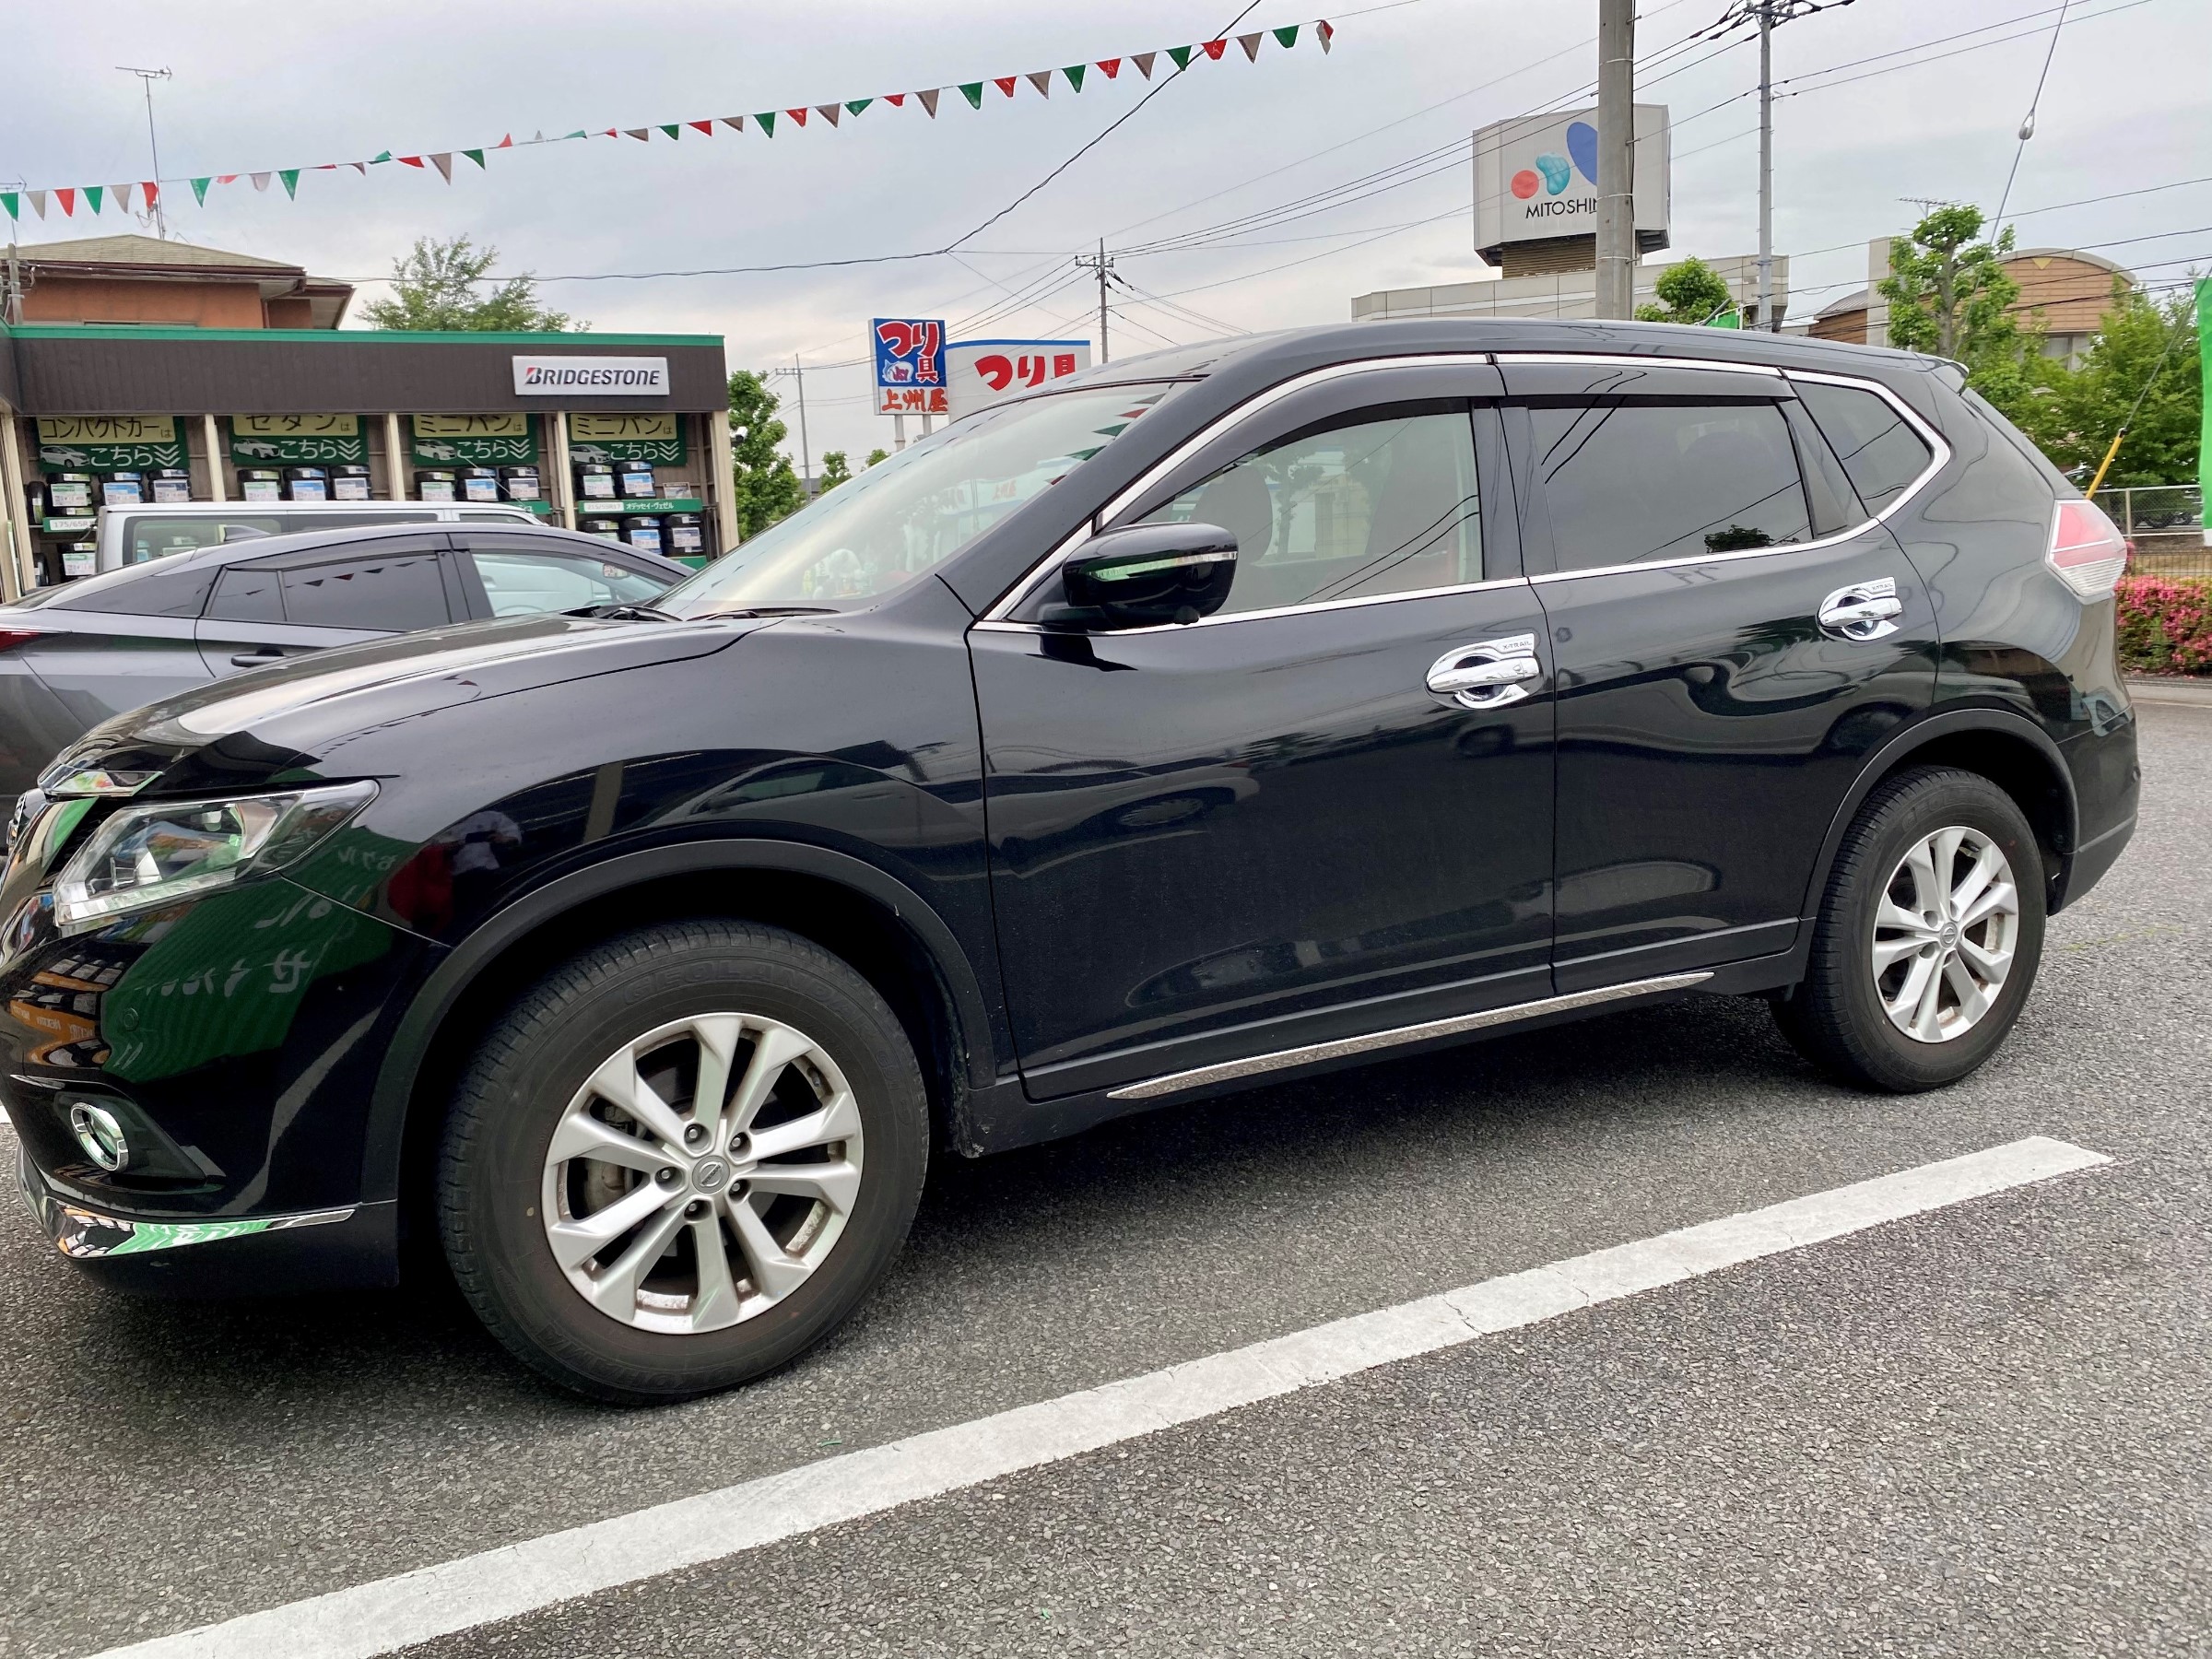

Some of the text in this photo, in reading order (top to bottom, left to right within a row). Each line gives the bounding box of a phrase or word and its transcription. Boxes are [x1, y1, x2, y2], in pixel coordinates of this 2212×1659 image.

[524, 366, 660, 386] BRIDGESTONE
[881, 388, 948, 413] 上州屋
[90, 445, 154, 467] こちら
[280, 439, 337, 459] こちら
[456, 439, 509, 459] こちら
[609, 441, 659, 461] こちら
[1502, 641, 1533, 651] X-TRAIL
